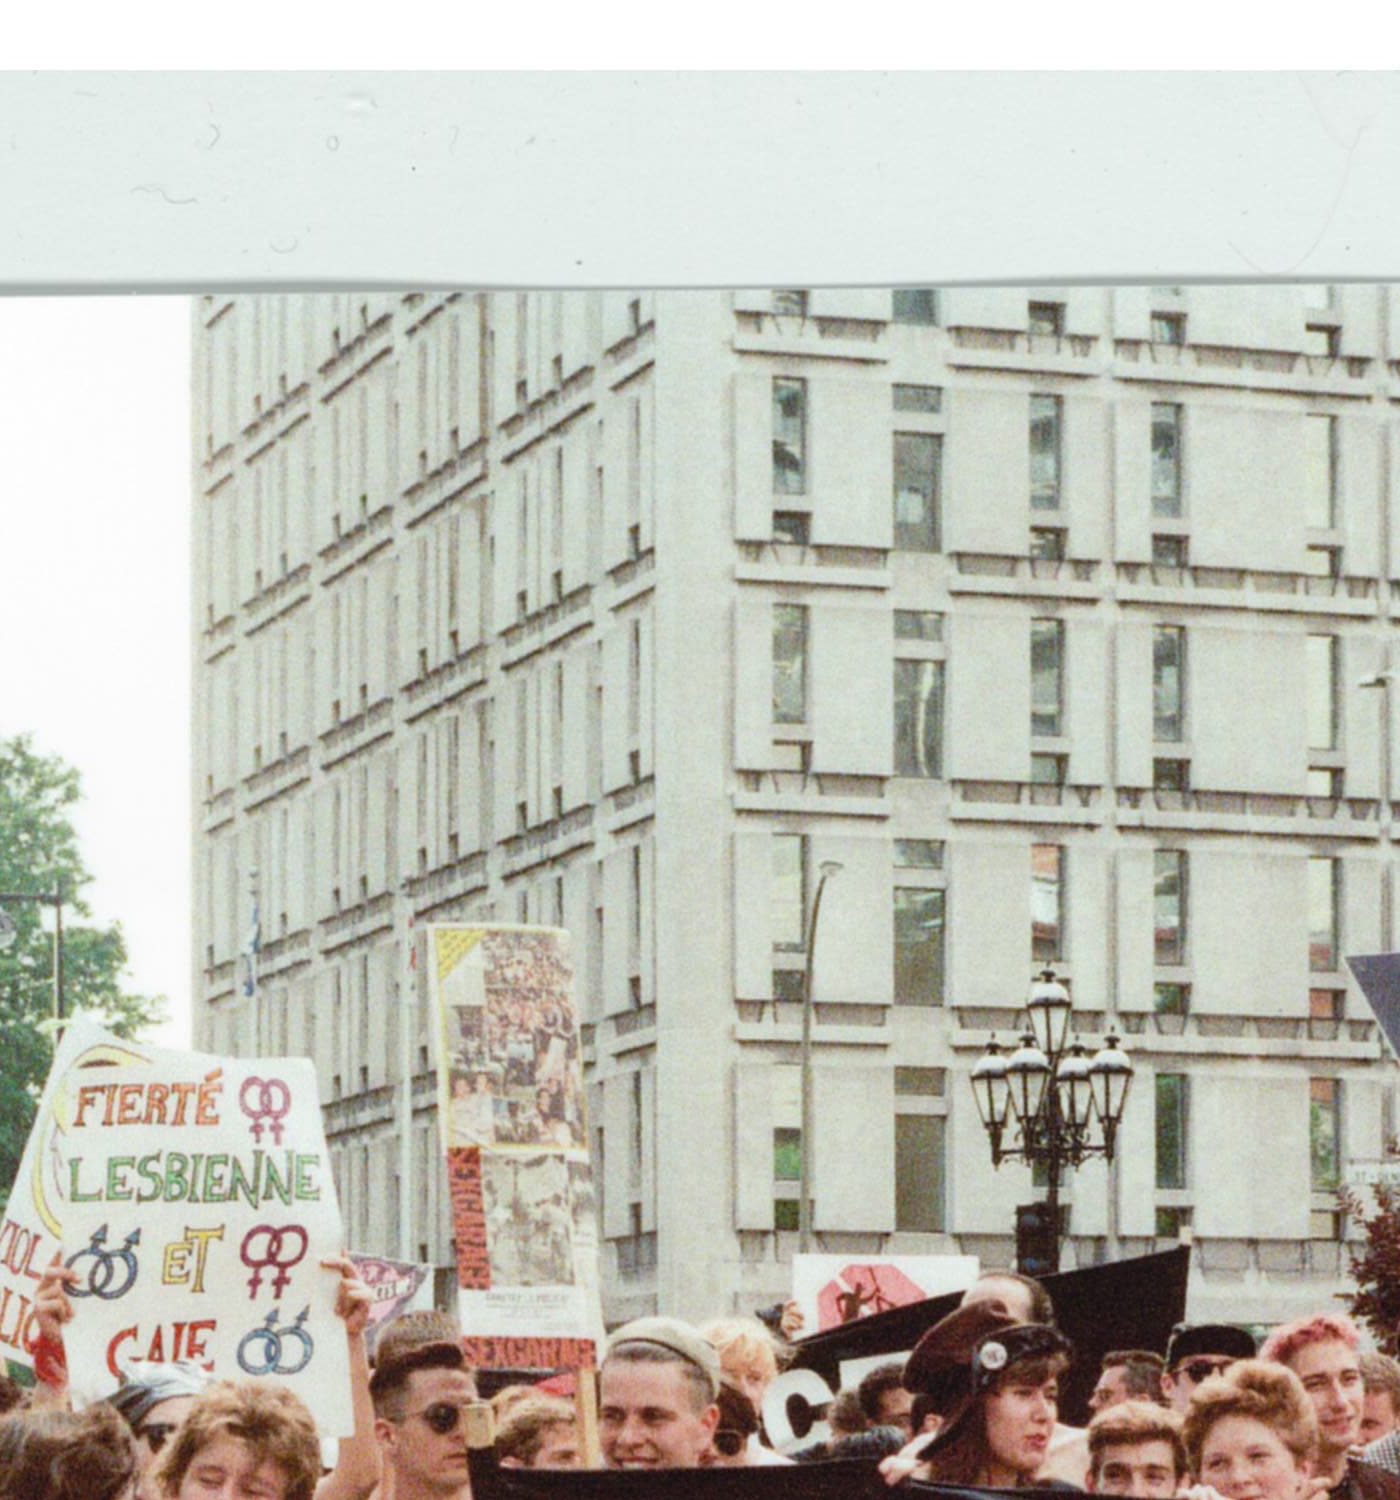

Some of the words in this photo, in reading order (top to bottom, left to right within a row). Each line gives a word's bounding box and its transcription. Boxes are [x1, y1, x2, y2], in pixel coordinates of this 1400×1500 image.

[72, 1069, 224, 1127] FIERTÉ
[68, 1149, 321, 1210] LESBIENNE
[161, 1224, 225, 1294] ET
